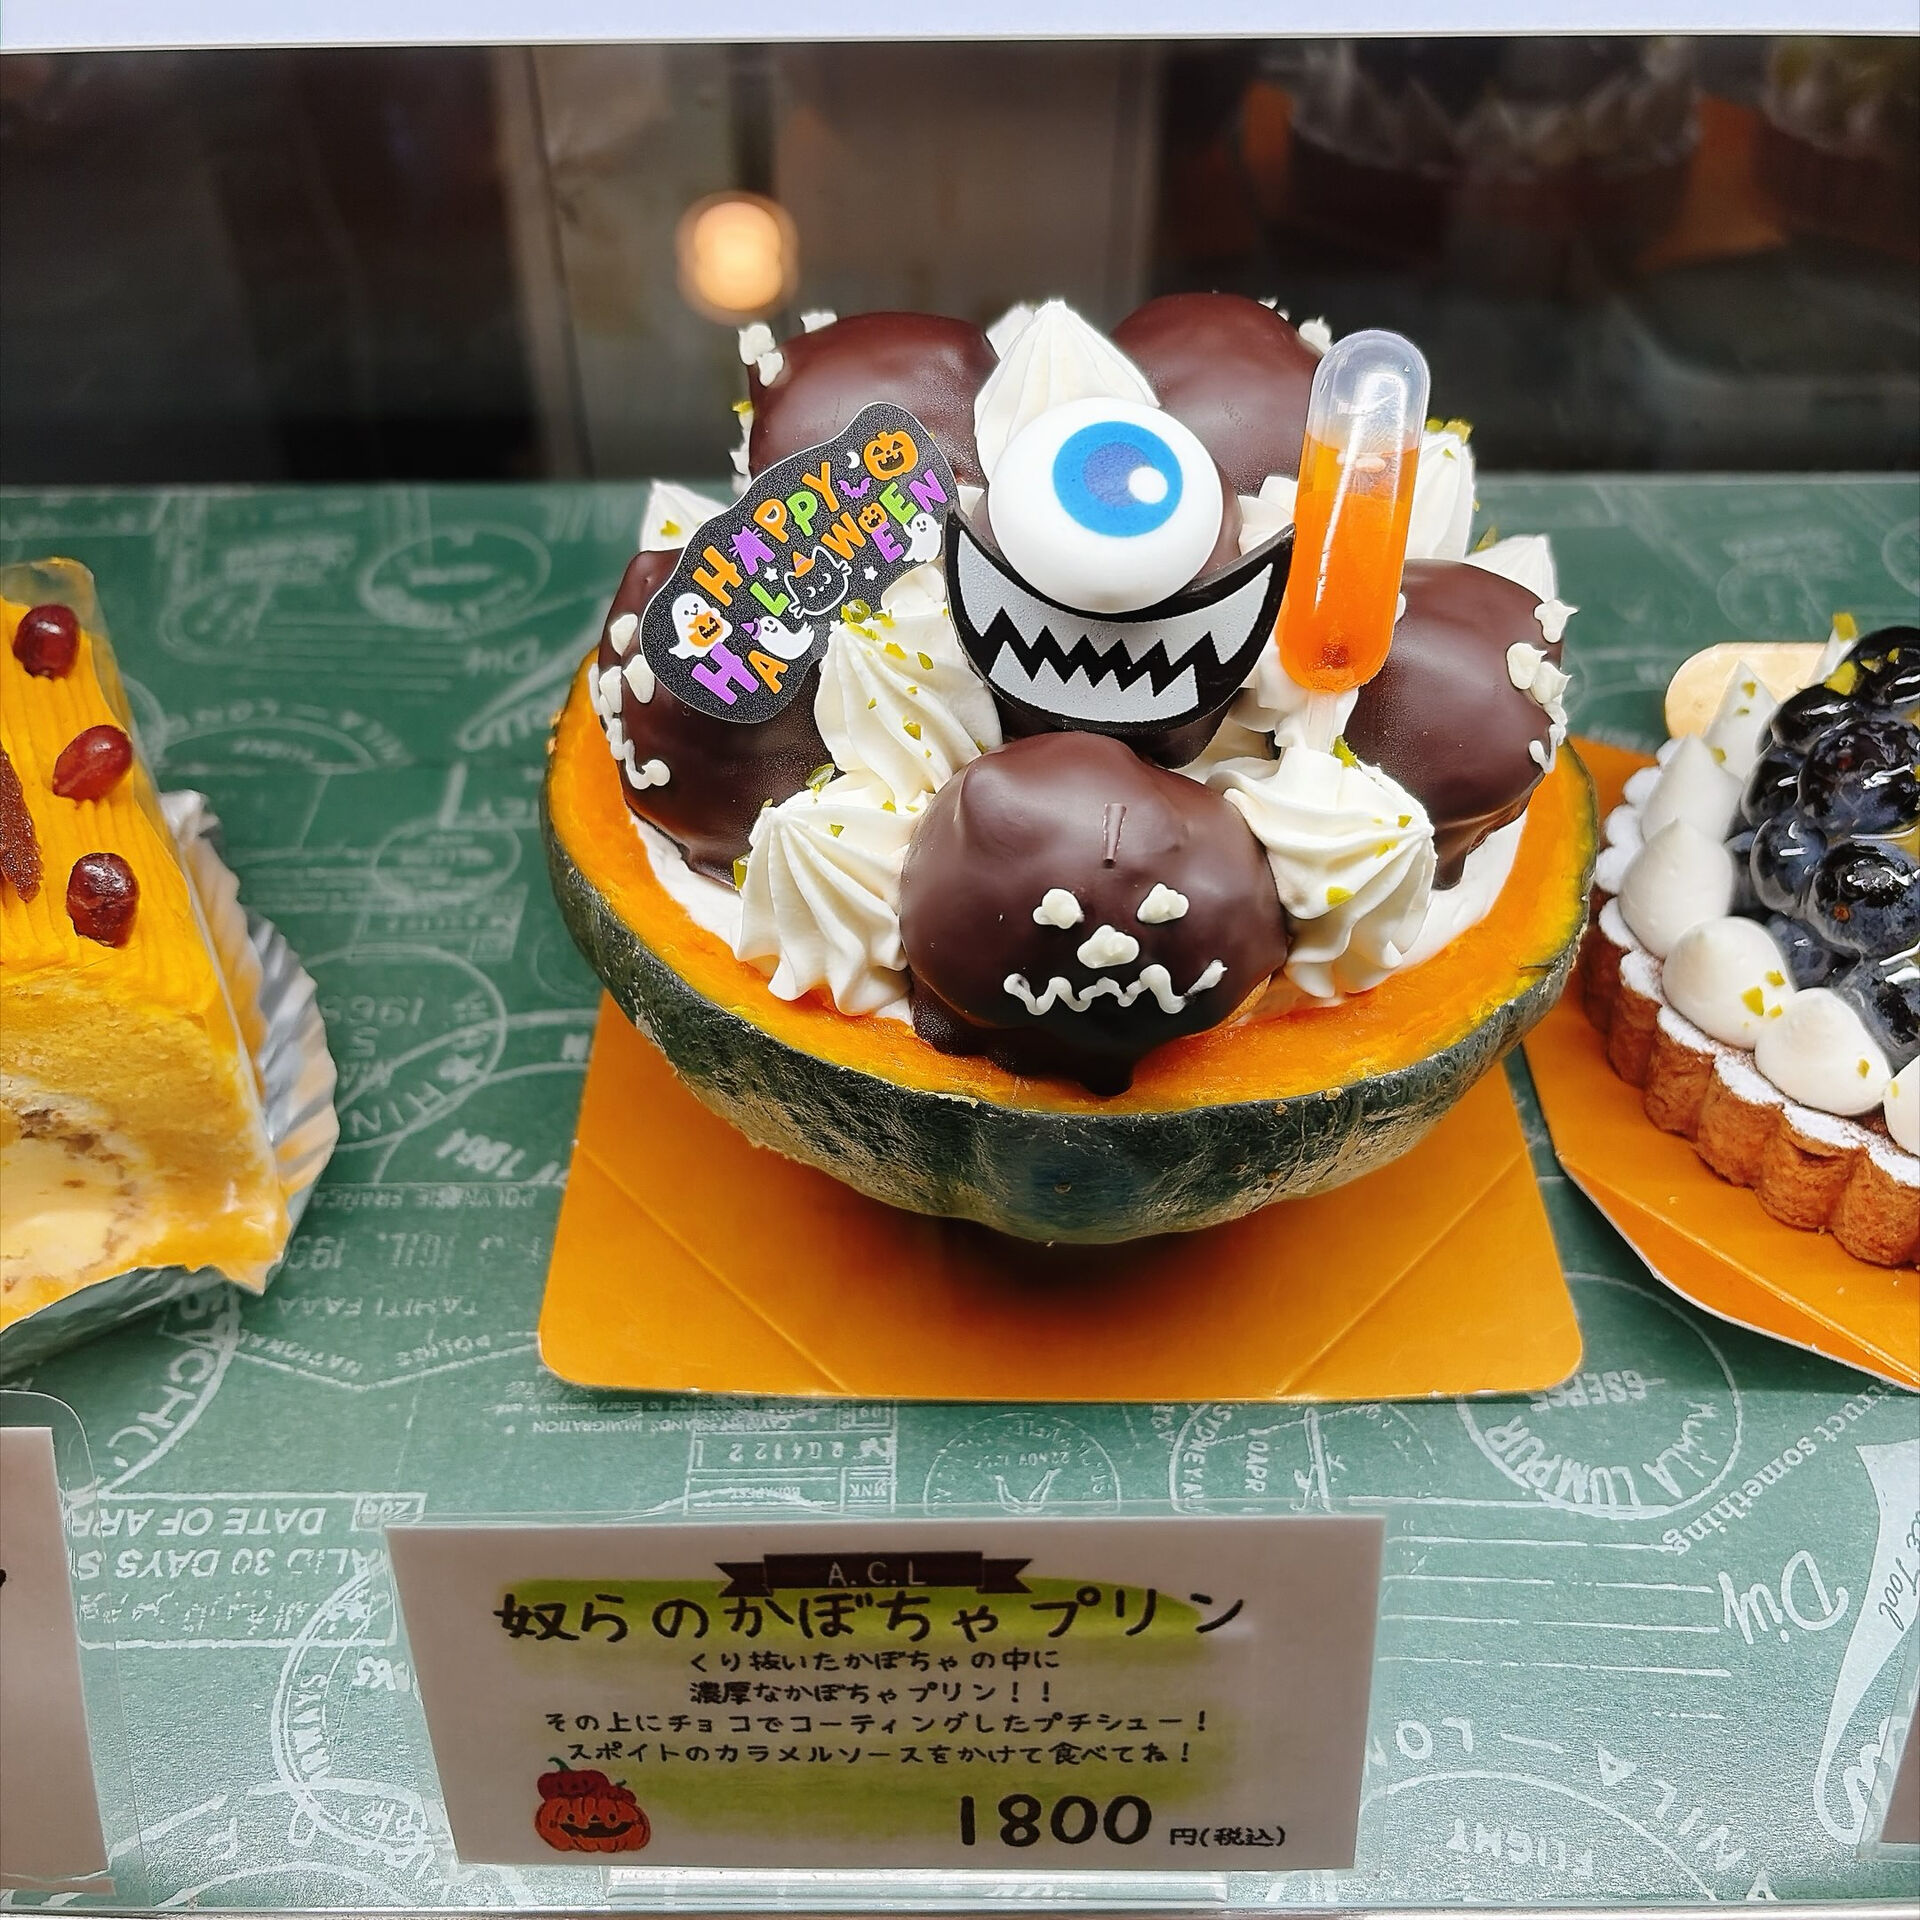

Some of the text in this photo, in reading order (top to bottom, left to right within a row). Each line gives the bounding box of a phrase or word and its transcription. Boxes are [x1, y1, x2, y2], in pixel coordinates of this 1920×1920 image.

[692, 461, 840, 607] HAPPY
[1660, 1433, 1820, 1556] something
[157, 1506, 215, 1536] OF
[224, 1506, 326, 1536] DATE
[116, 1546, 218, 1579] DAYS
[231, 1547, 275, 1576] 30
[829, 1561, 928, 1587] A.C.L
[494, 1587, 1244, 1645] 奴らのかぼちゃプリン
[689, 1649, 1060, 1673] くり抜いたかぼちゃの中に
[960, 1794, 1286, 1848] 1800 円(税込)
